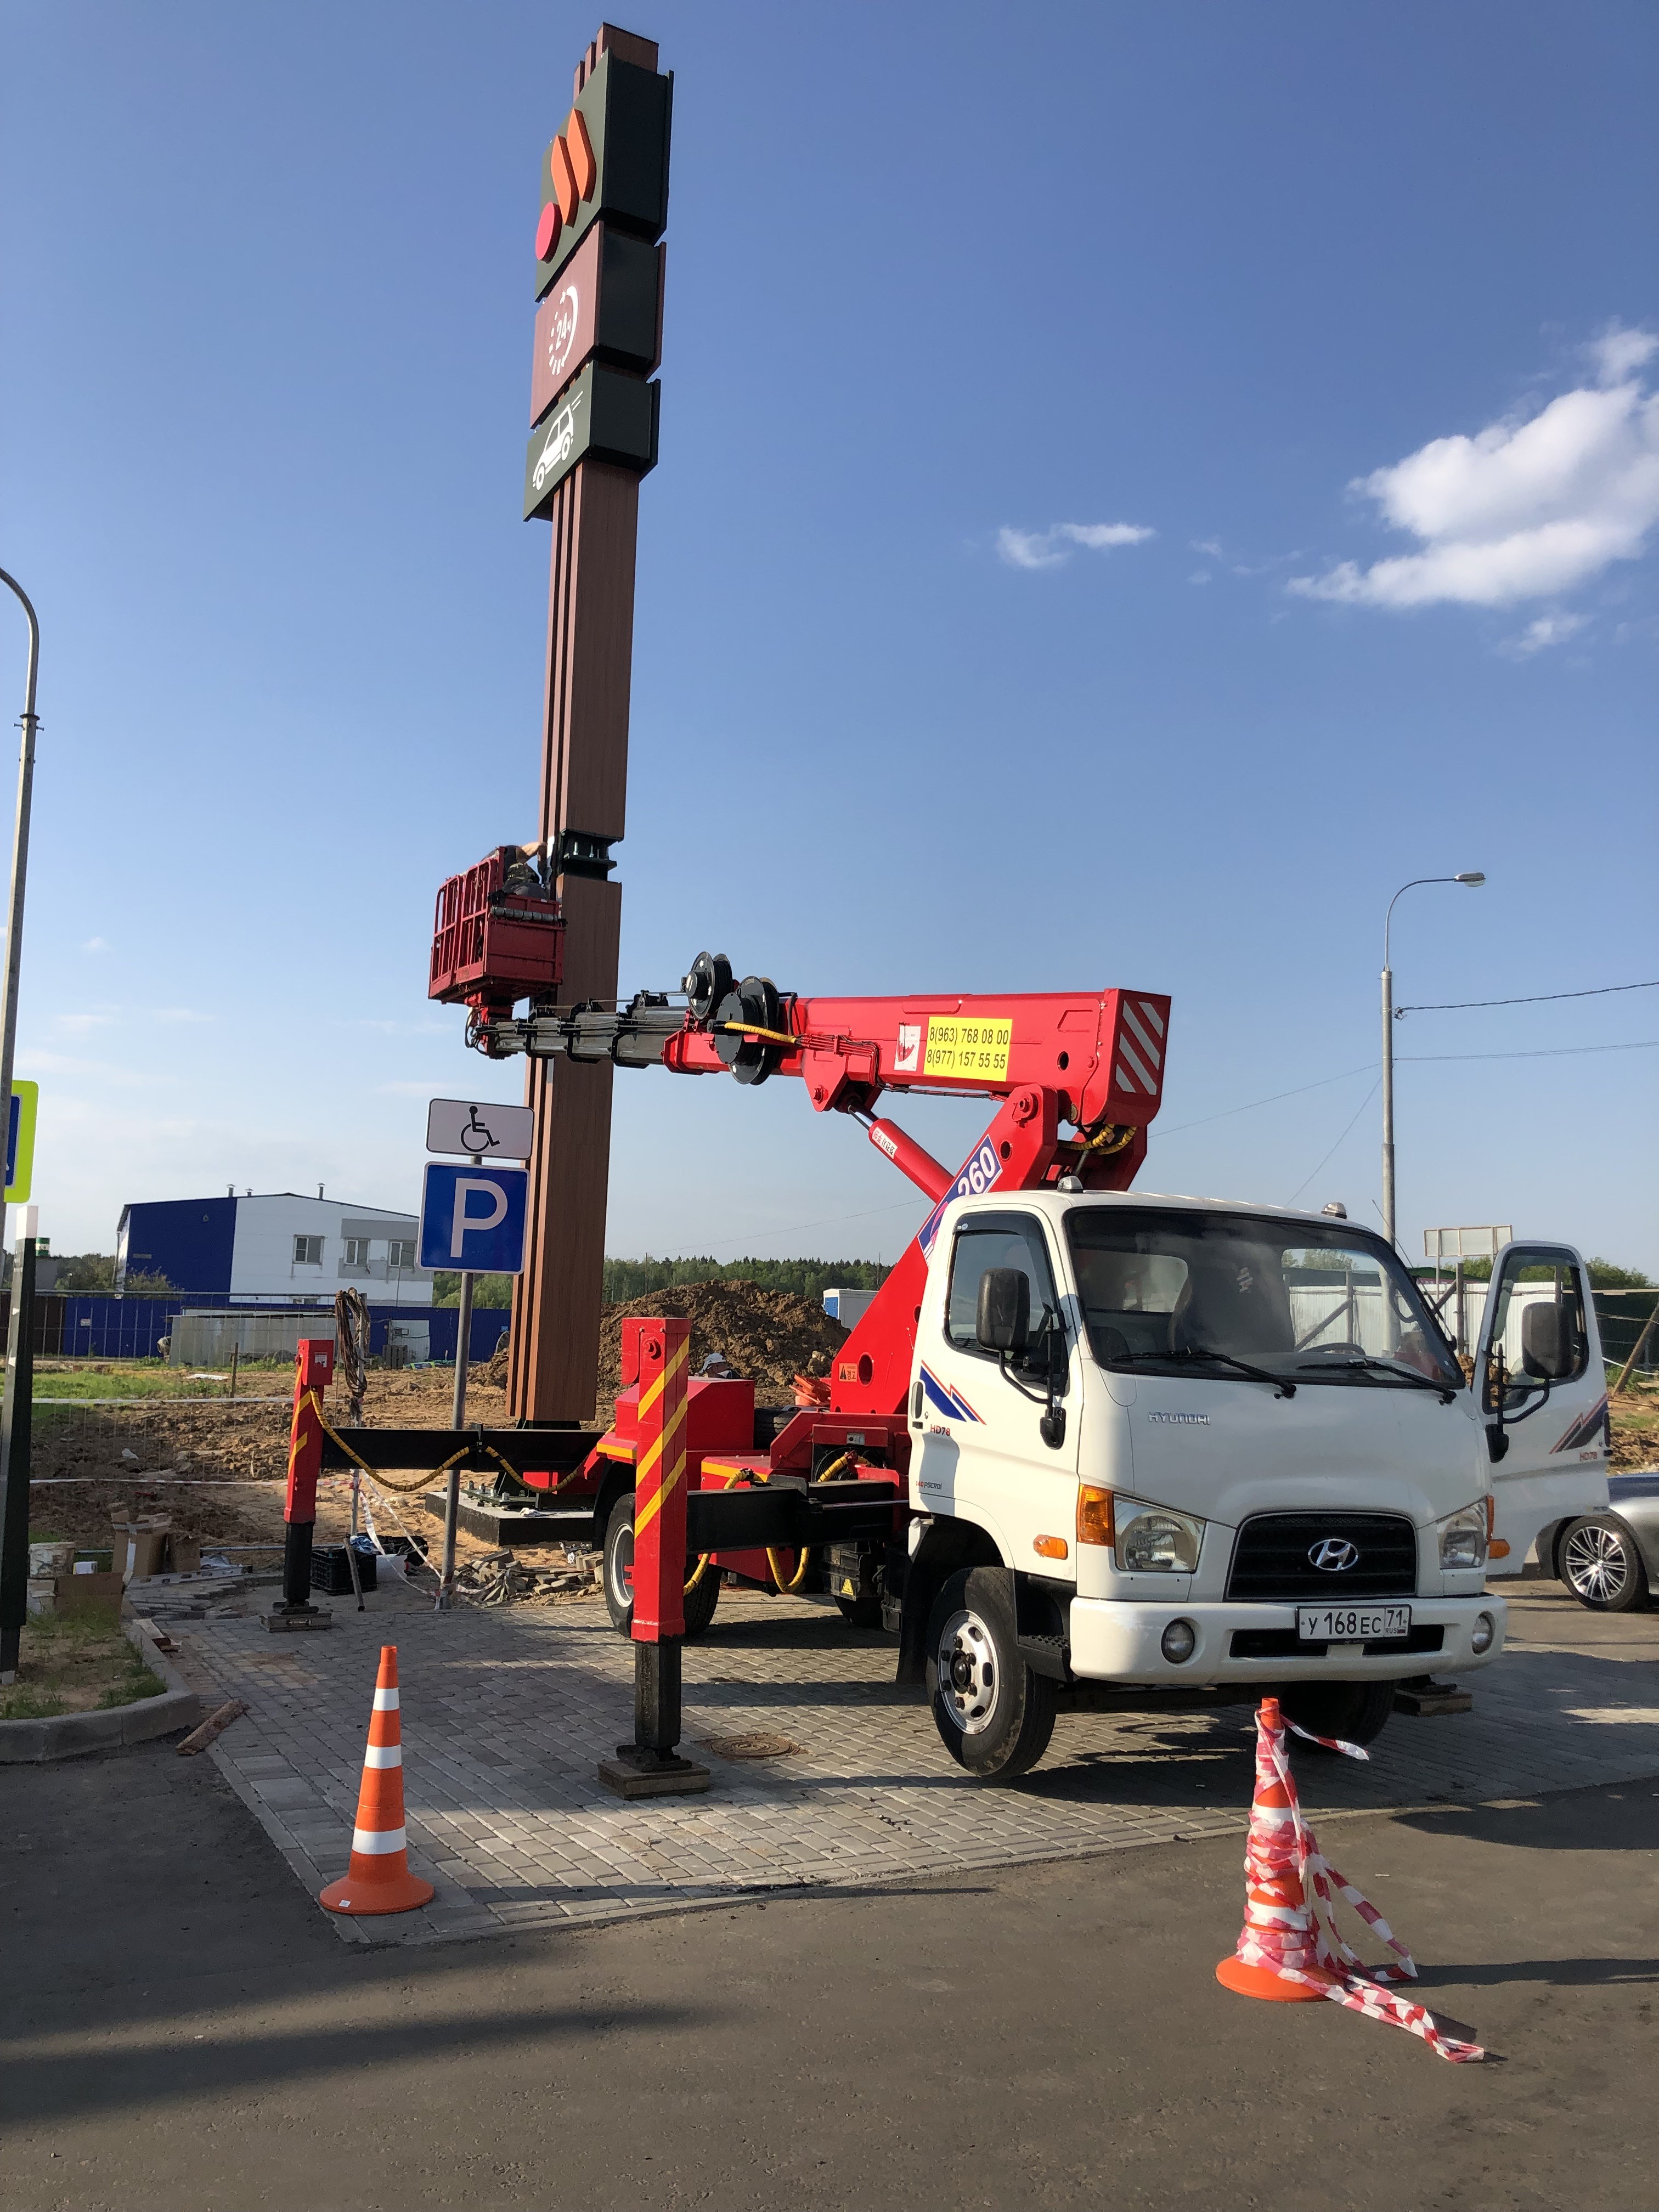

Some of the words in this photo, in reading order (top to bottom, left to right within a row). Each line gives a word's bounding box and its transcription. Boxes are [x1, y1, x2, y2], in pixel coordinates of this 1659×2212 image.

[929, 1026, 957, 1046] 8(963)
[961, 1028, 978, 1043] 768
[981, 1029, 994, 1045] 08
[996, 1030, 1009, 1045] 00
[927, 1049, 955, 1069] 8(977)
[959, 1051, 976, 1066] 157
[978, 1053, 991, 1068] 55
[994, 1054, 1006, 1069] 55
[450, 1177, 508, 1258] P
[1148, 1411, 1210, 1425] HYUNDAI
[930, 1424, 950, 1436] HD78
[1387, 1609, 1403, 1627] 71
